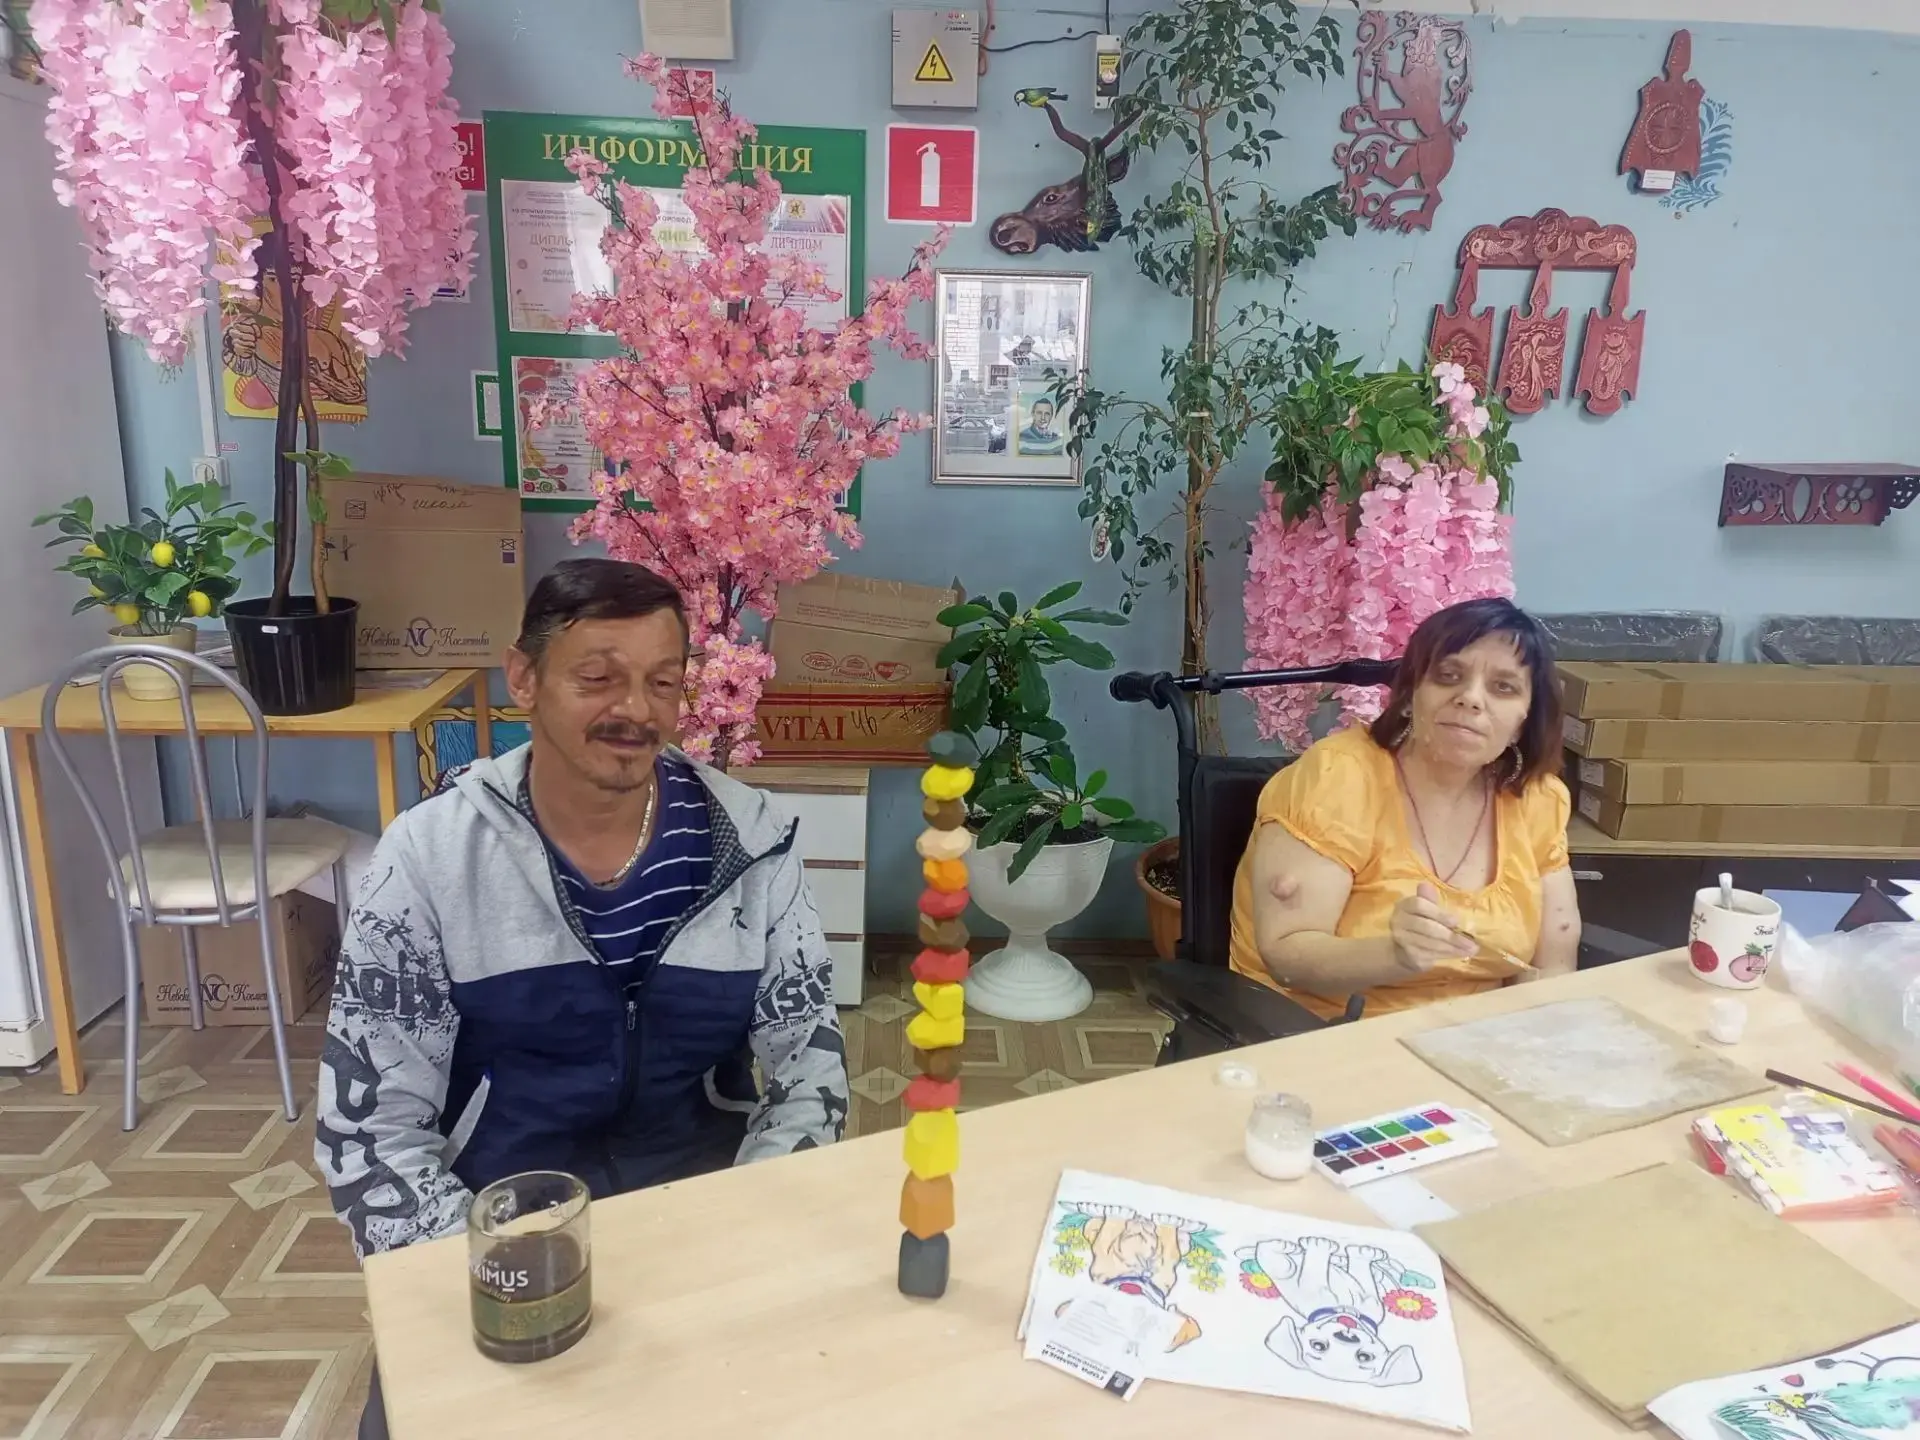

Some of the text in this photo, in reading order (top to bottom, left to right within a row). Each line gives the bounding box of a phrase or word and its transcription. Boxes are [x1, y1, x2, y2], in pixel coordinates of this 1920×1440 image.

[541, 134, 813, 174] ИНФОРМЦИЯ
[156, 983, 192, 1002] Невск
[471, 1264, 529, 1289] XIMUS
